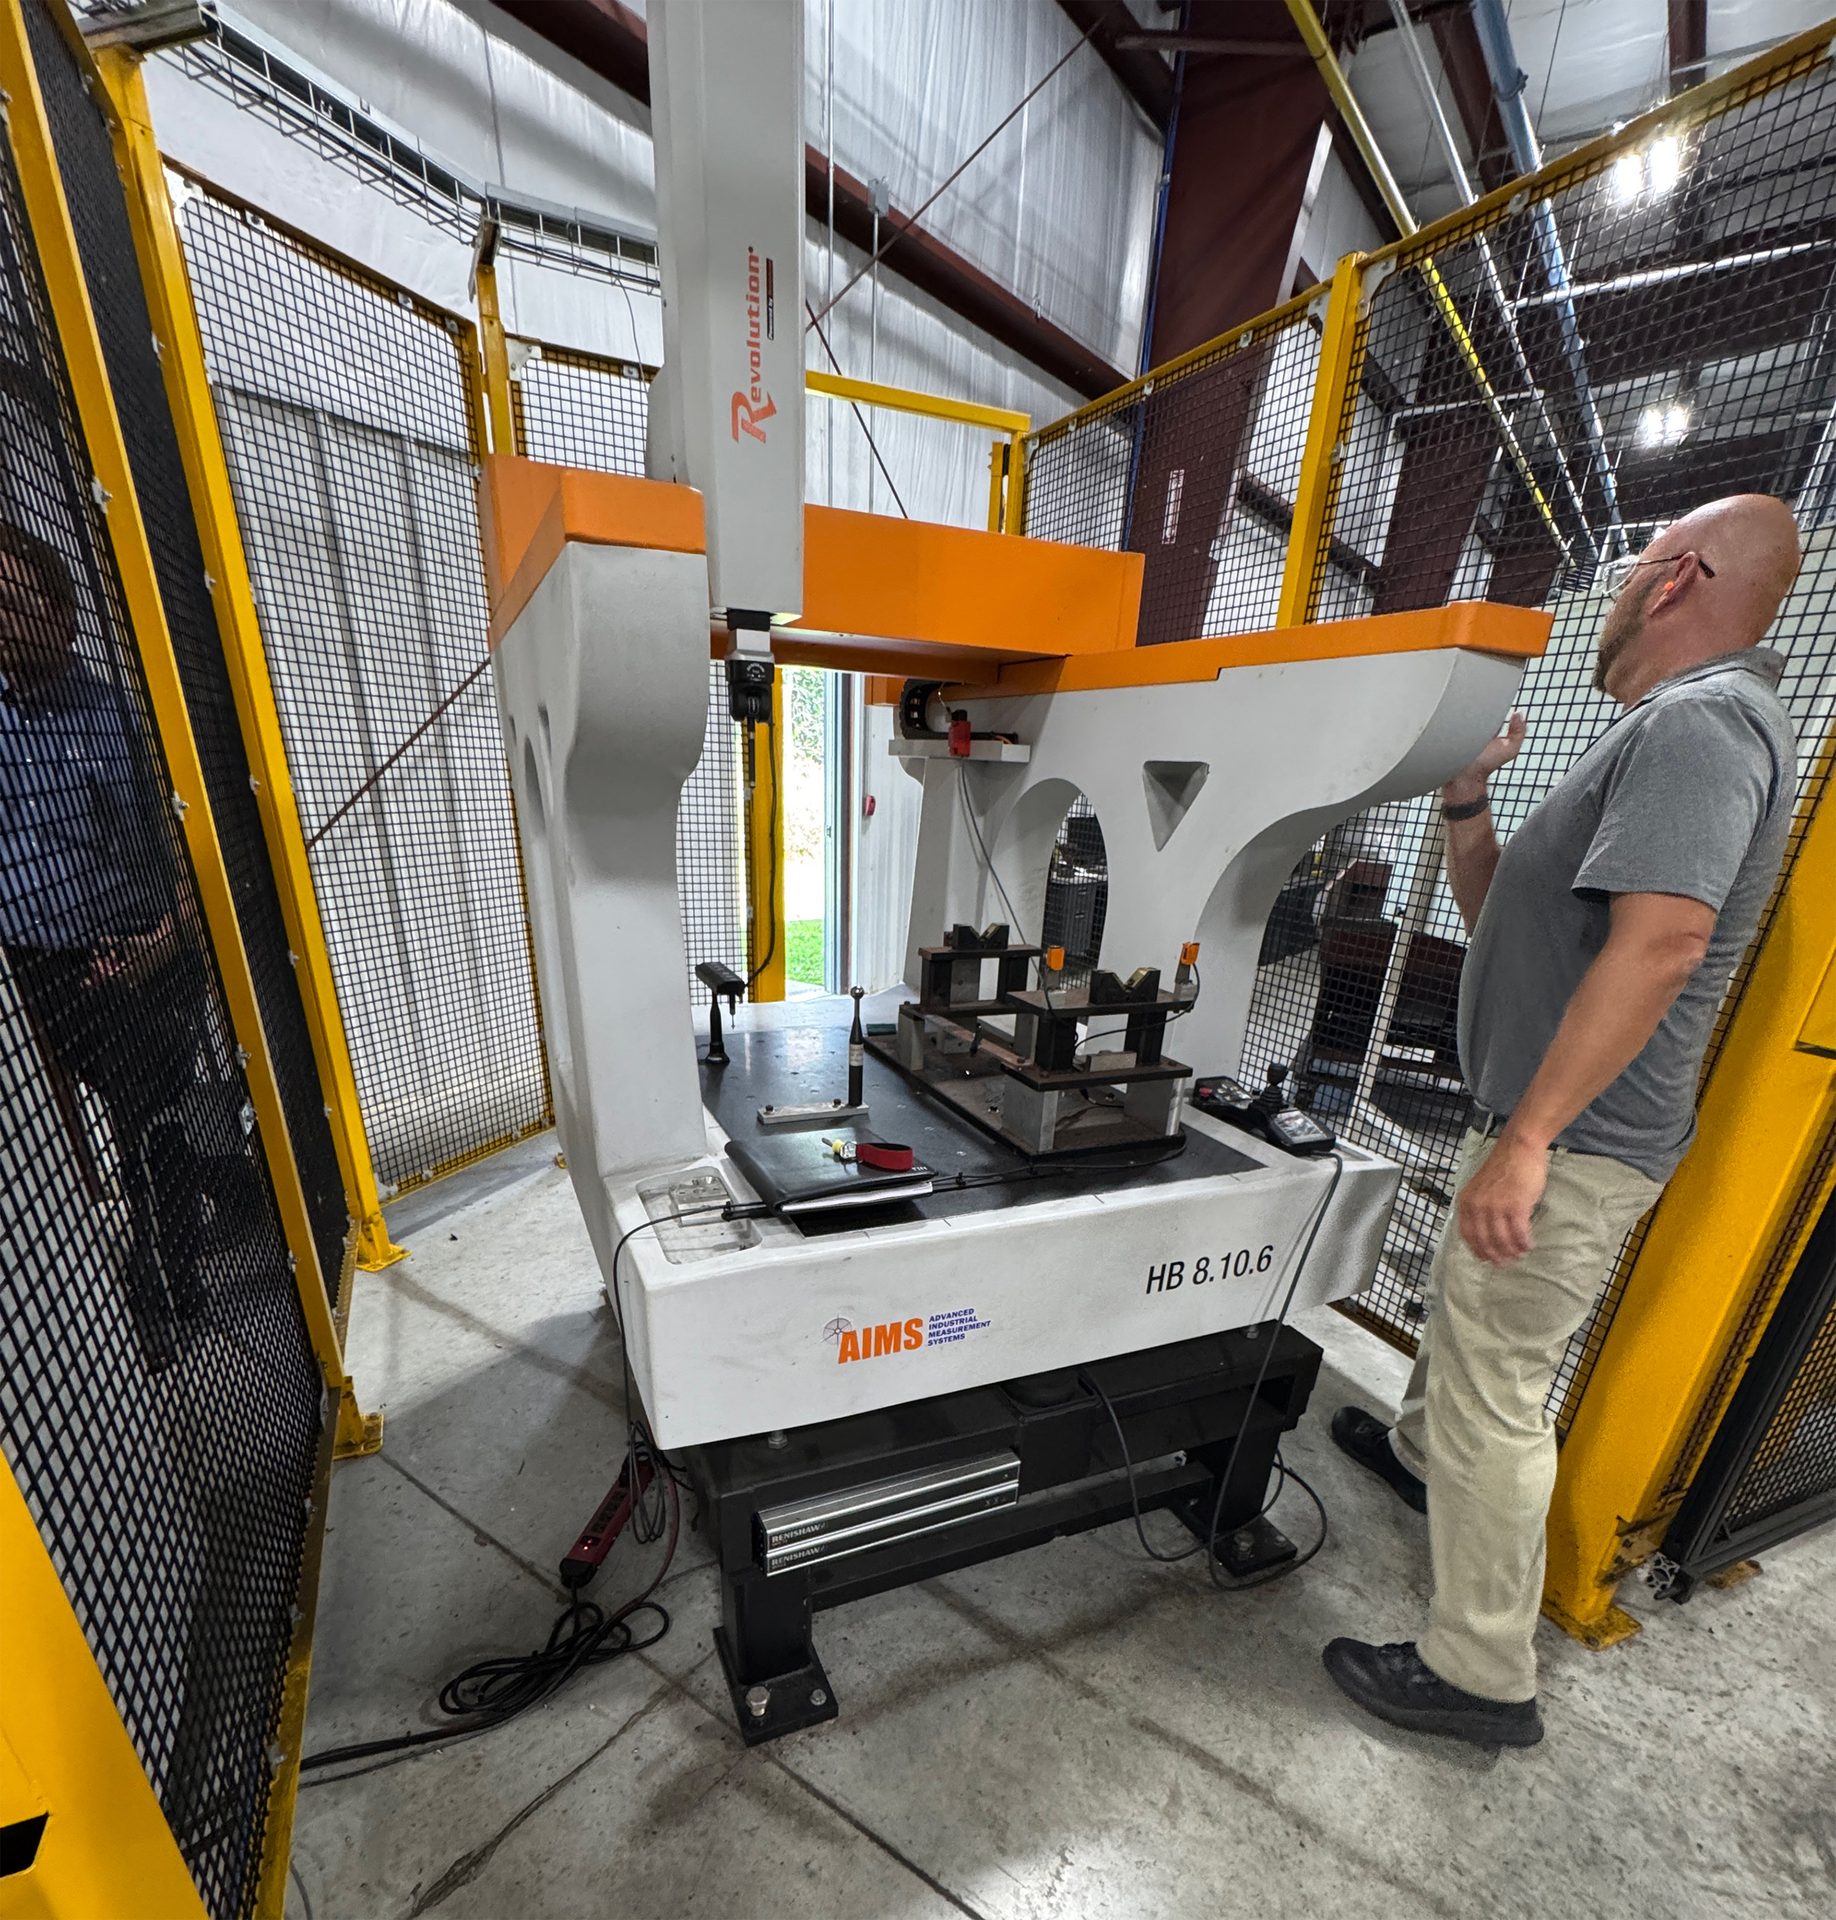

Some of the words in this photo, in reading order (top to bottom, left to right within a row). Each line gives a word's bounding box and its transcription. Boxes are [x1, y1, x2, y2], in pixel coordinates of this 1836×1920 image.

[731, 254, 776, 443] Revolution
[1146, 1261, 1185, 1294] HB
[1192, 1245, 1273, 1285] 8.10.6
[928, 1315, 979, 1330] INDUSTRIAL
[929, 1308, 975, 1322] ADVANCED
[928, 1320, 992, 1338] MEASUREMENT
[838, 1318, 924, 1364] AIMS
[927, 1333, 966, 1347] SYSTEMS
[772, 1524, 820, 1543] RENISHAW
[772, 1547, 820, 1566] RENISHAW
